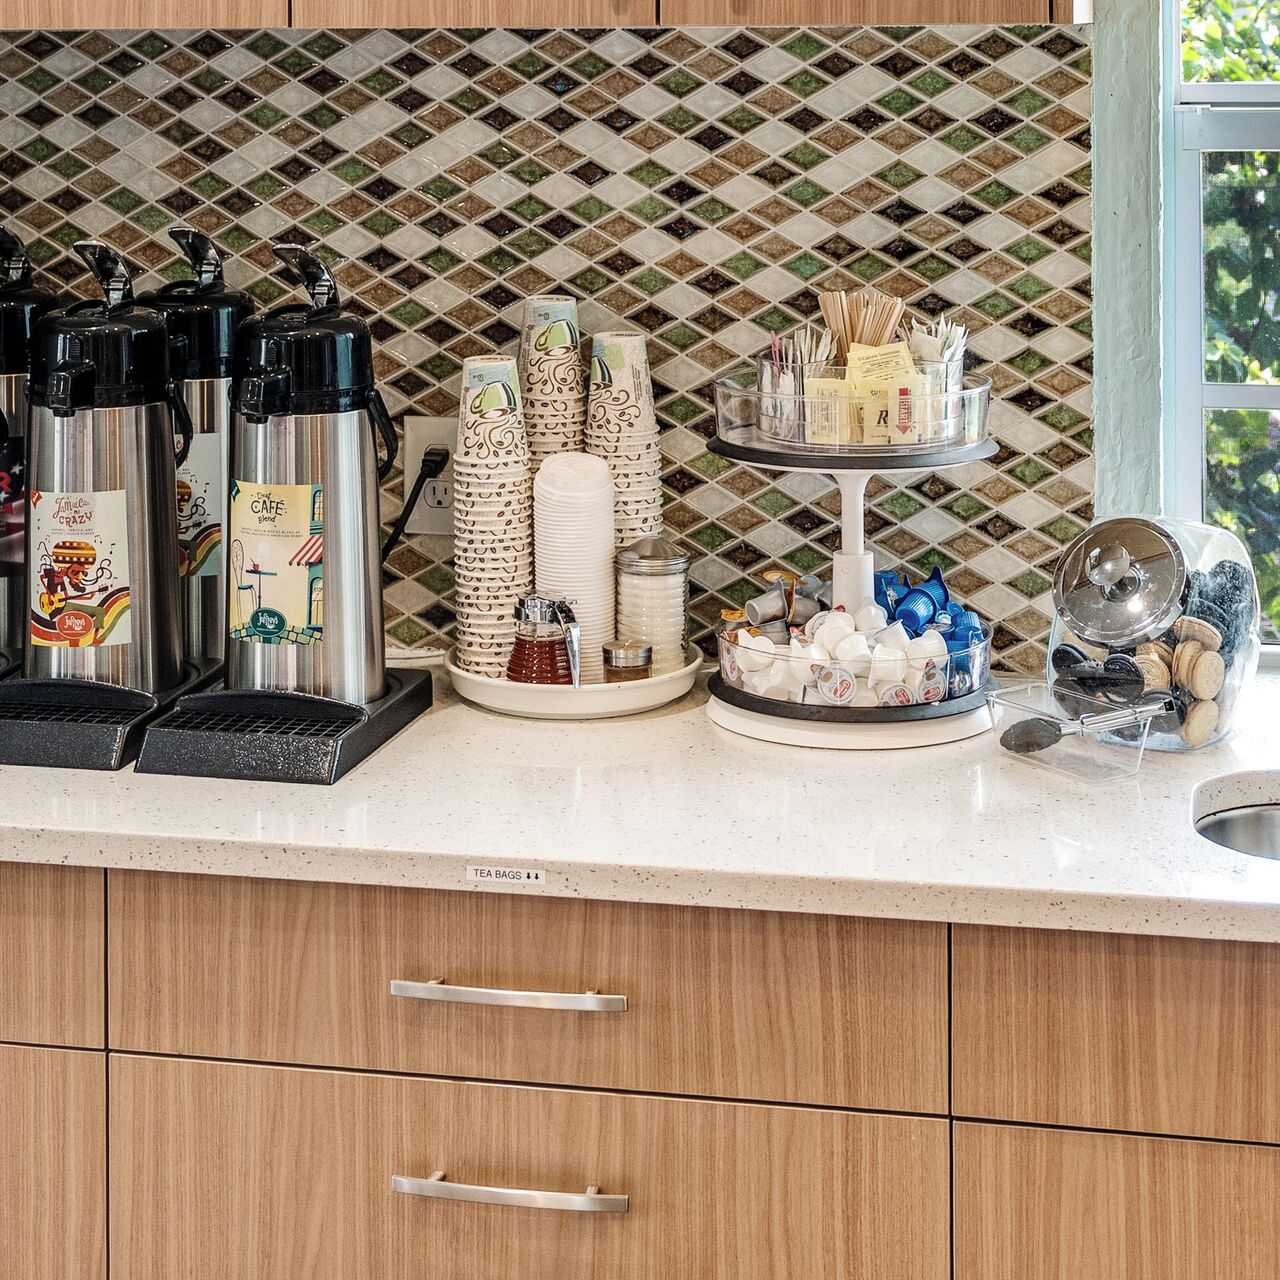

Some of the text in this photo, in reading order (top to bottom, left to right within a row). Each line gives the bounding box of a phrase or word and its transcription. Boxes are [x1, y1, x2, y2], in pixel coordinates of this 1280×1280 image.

[251, 499, 285, 517] CAFÉ
[58, 510, 93, 528] CRAZY
[258, 514, 277, 524] Blend
[473, 869, 522, 880] TEA BAGS
